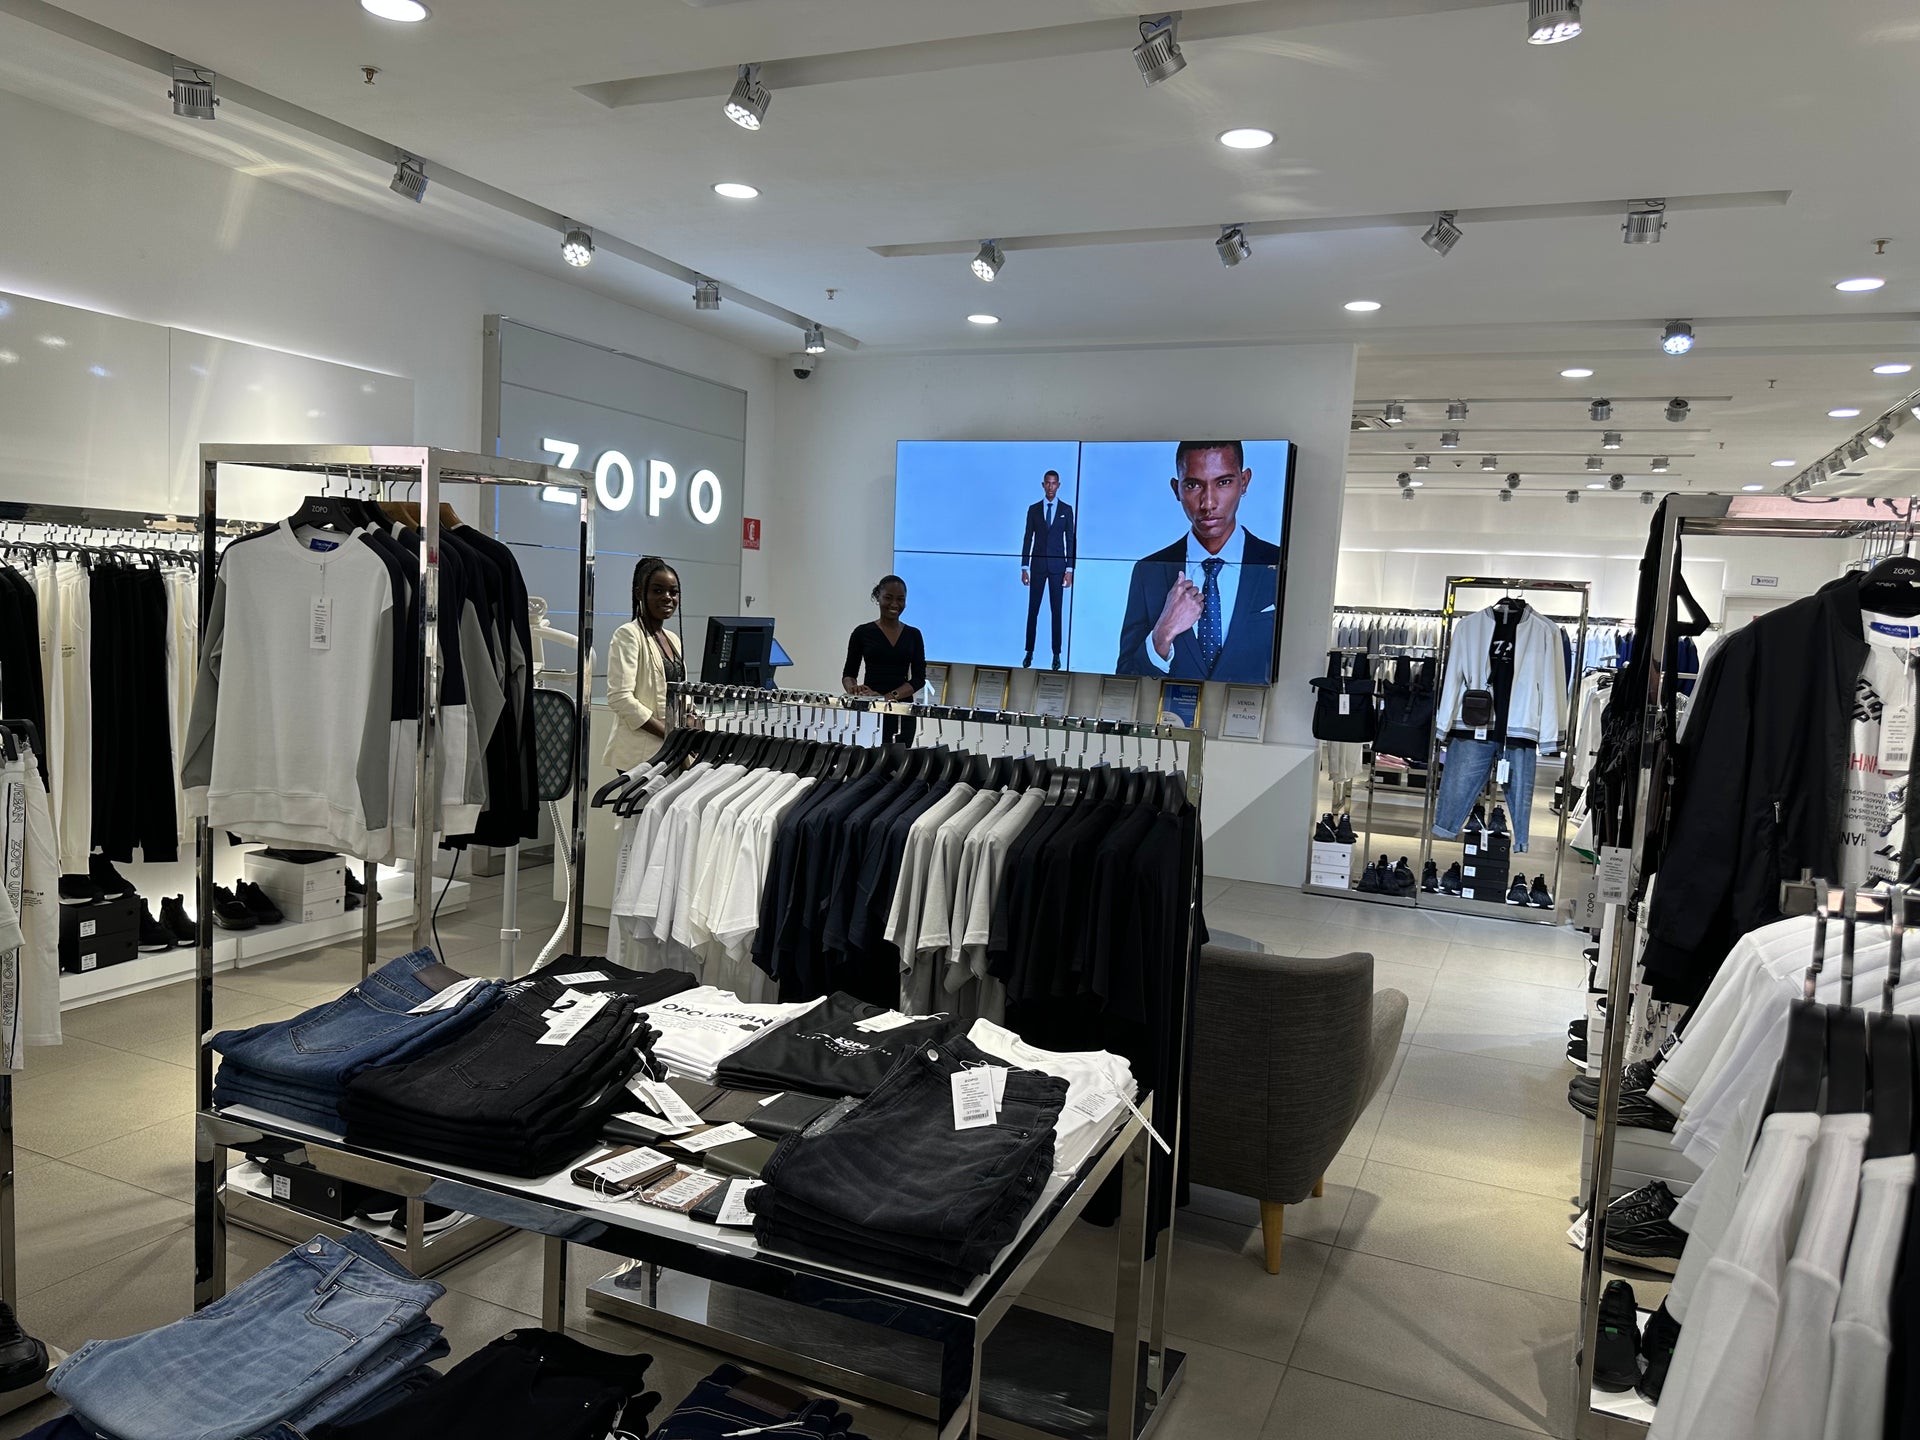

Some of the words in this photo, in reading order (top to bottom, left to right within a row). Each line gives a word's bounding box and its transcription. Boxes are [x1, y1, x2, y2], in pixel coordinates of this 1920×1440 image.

[542, 437, 722, 525] ZOPO
[311, 505, 328, 513] ZOPO
[1893, 567, 1916, 576] ZOPO
[10, 840, 22, 878] ZOPO
[1586, 892, 1596, 913] ZOPO
[4, 950, 14, 980] OPO
[705, 1012, 774, 1027] URBAN
